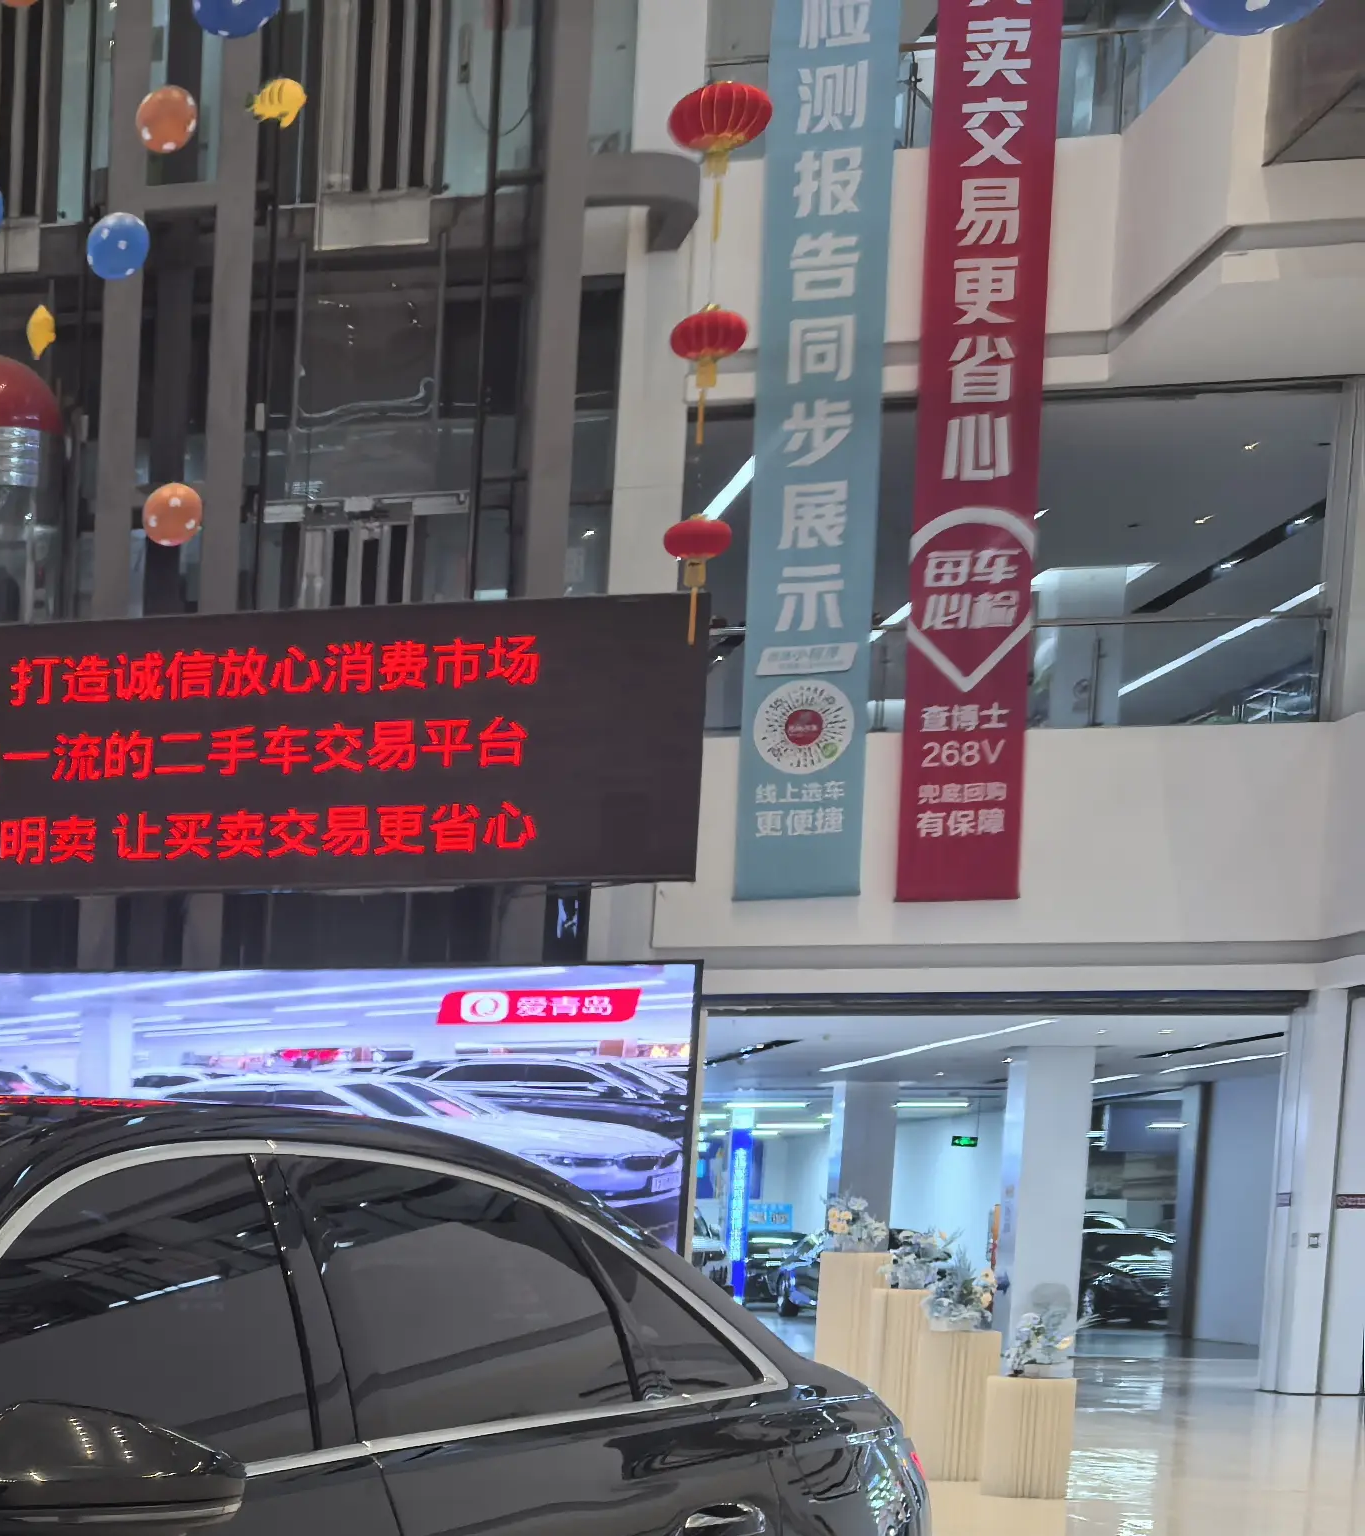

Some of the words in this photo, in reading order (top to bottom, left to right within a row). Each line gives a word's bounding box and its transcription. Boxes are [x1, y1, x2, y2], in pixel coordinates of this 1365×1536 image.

[942, 0, 1032, 481] 卖交易更省心
[777, 0, 870, 632] 检测报告同步展示
[11, 637, 539, 706] 打造诚信放心消费市场
[920, 702, 1010, 732] 查博士
[921, 739, 1006, 768] 268V
[112, 802, 536, 860] 让买卖交易更省心
[755, 807, 844, 838] 更便捷
[917, 809, 1006, 838] 有保障
[516, 995, 613, 1017] 爱青岛
